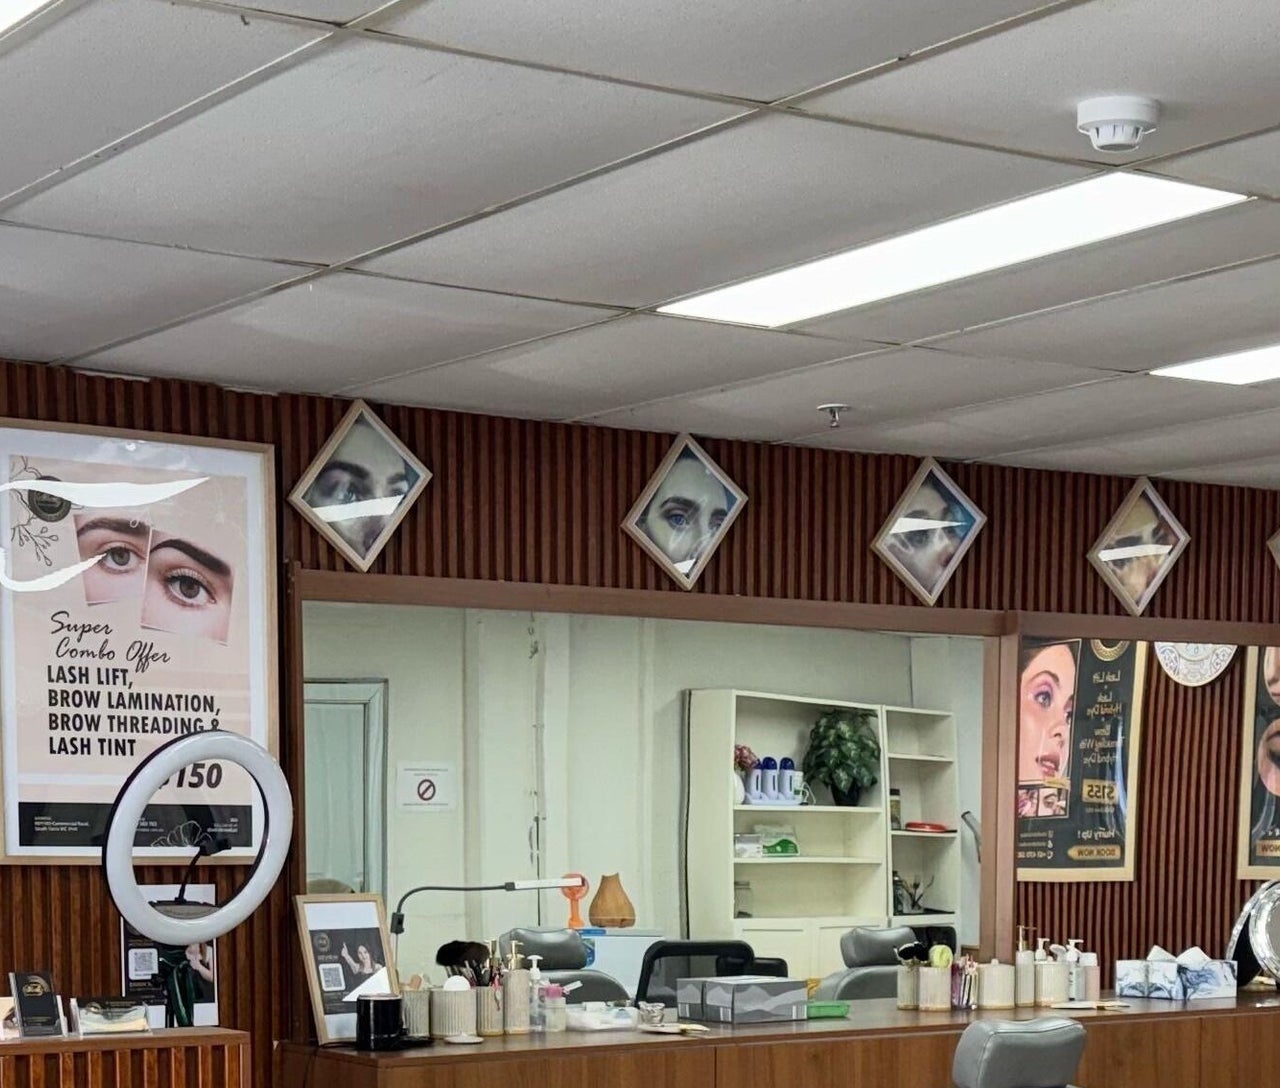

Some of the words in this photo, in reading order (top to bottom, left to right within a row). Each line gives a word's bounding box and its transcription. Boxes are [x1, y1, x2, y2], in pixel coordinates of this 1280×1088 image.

[50, 610, 113, 643] Super
[55, 636, 116, 661] Combo
[125, 640, 171, 673] Offer
[47, 665, 89, 685] LASH
[97, 667, 133, 690] LIFT,
[48, 689, 101, 709] BROW
[107, 691, 221, 716] LAMINATION,
[48, 713, 101, 732] BROW
[107, 714, 205, 734] THREADING
[49, 737, 91, 755] LASH
[98, 738, 137, 757] TINT
